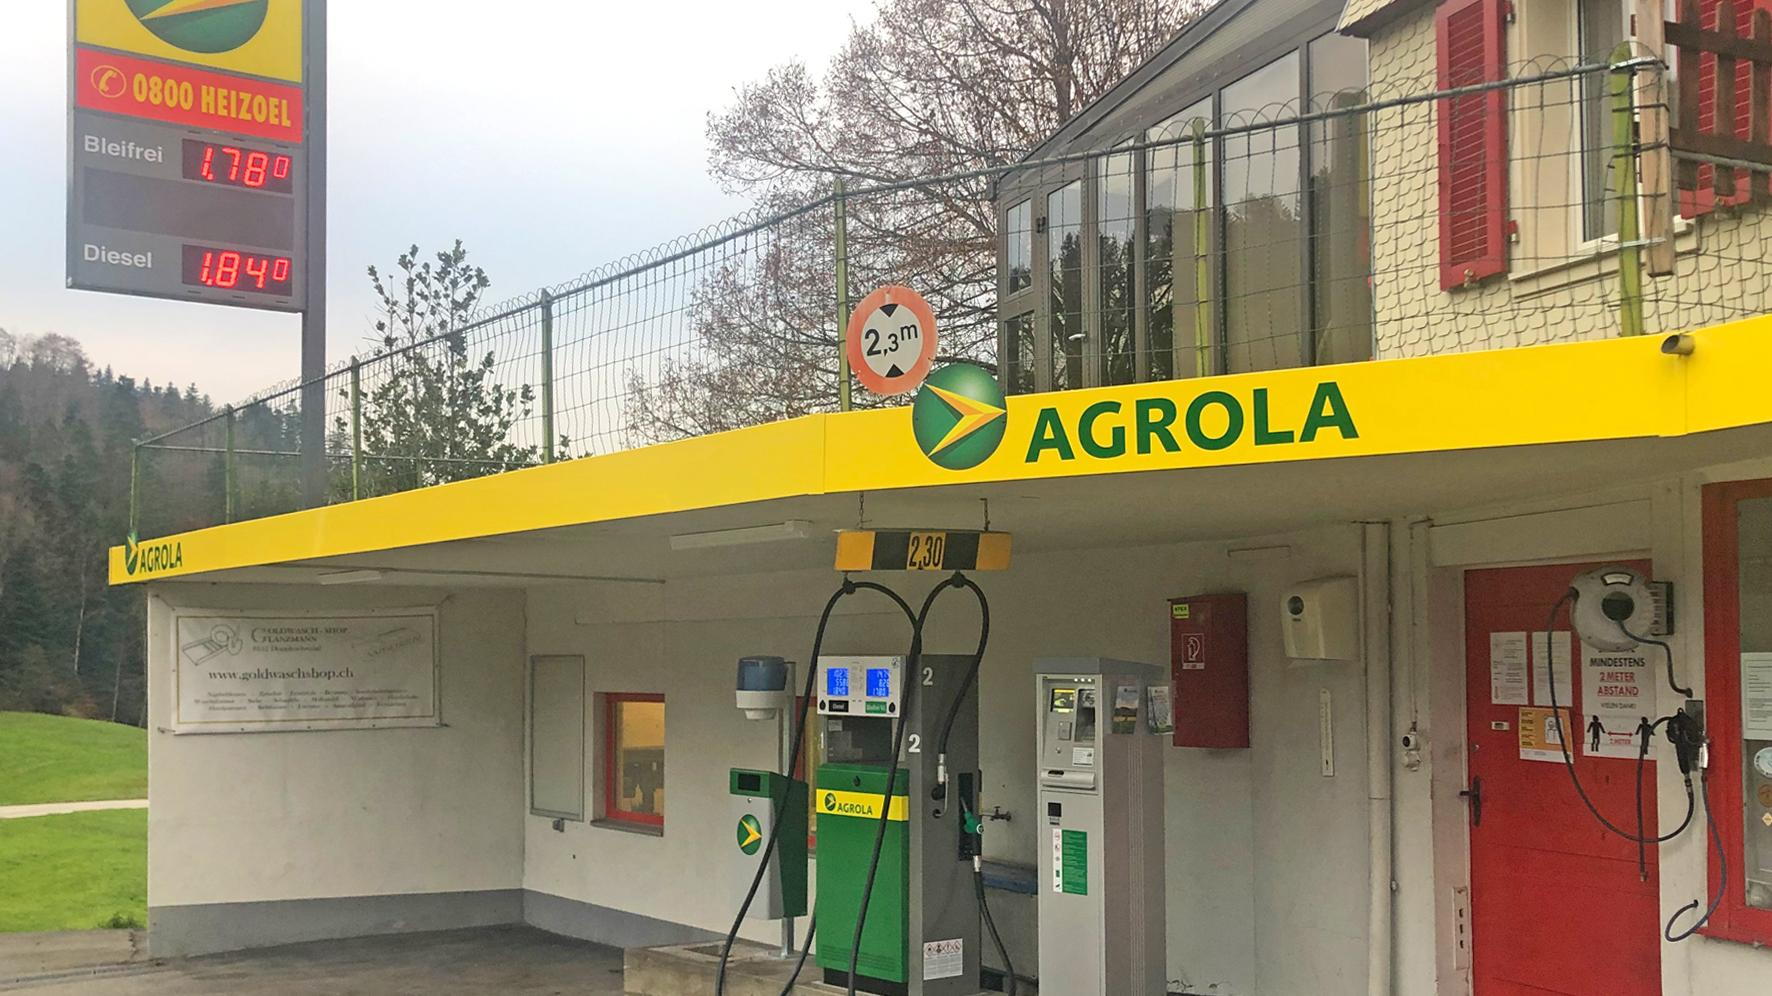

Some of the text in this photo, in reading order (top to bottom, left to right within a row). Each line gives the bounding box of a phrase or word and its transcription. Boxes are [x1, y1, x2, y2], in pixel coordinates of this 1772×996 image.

[132, 73, 292, 128] 0800 HEIZOEL
[83, 134, 163, 163] Bleifrei
[83, 243, 153, 269] Diesel
[1025, 381, 1360, 463] AGROLA
[140, 542, 183, 573] AGROLA
[908, 535, 944, 570] 2,30
[1590, 657, 1646, 668] MINDESTENS
[208, 666, 355, 682] www.goldwaschshop.ch
[922, 667, 933, 686] 2
[1600, 672, 1635, 682] 2 METER
[1597, 686, 1639, 696] ABSTAND
[908, 733, 920, 753] 2
[837, 803, 873, 815] AGROLA
